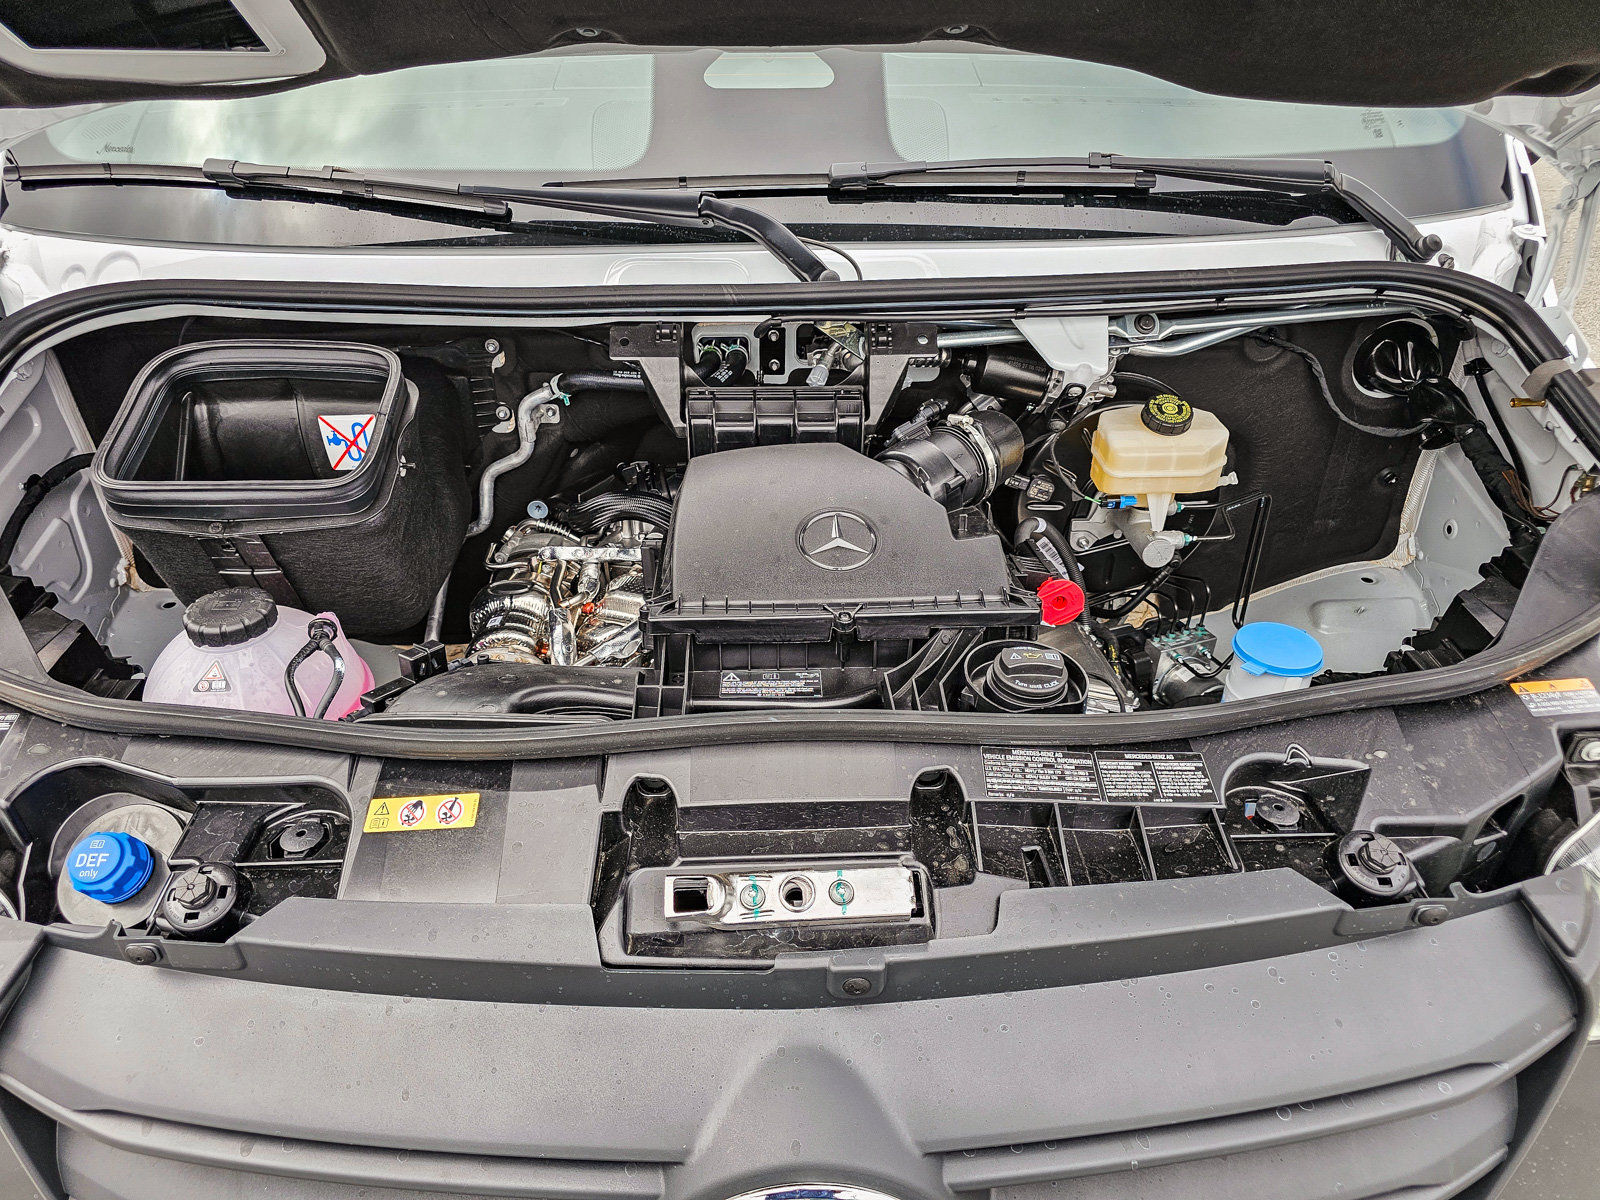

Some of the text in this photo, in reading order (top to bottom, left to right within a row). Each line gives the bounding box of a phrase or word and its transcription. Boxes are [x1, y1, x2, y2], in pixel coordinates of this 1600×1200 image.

[1015, 679, 1028, 687] Turn
[983, 753, 1006, 761] VEHICLE
[1032, 756, 1056, 764] CONTROL
[1011, 749, 1054, 758] MERCEDES-BENZ
[75, 853, 110, 868] DEF
[79, 868, 98, 880] only
